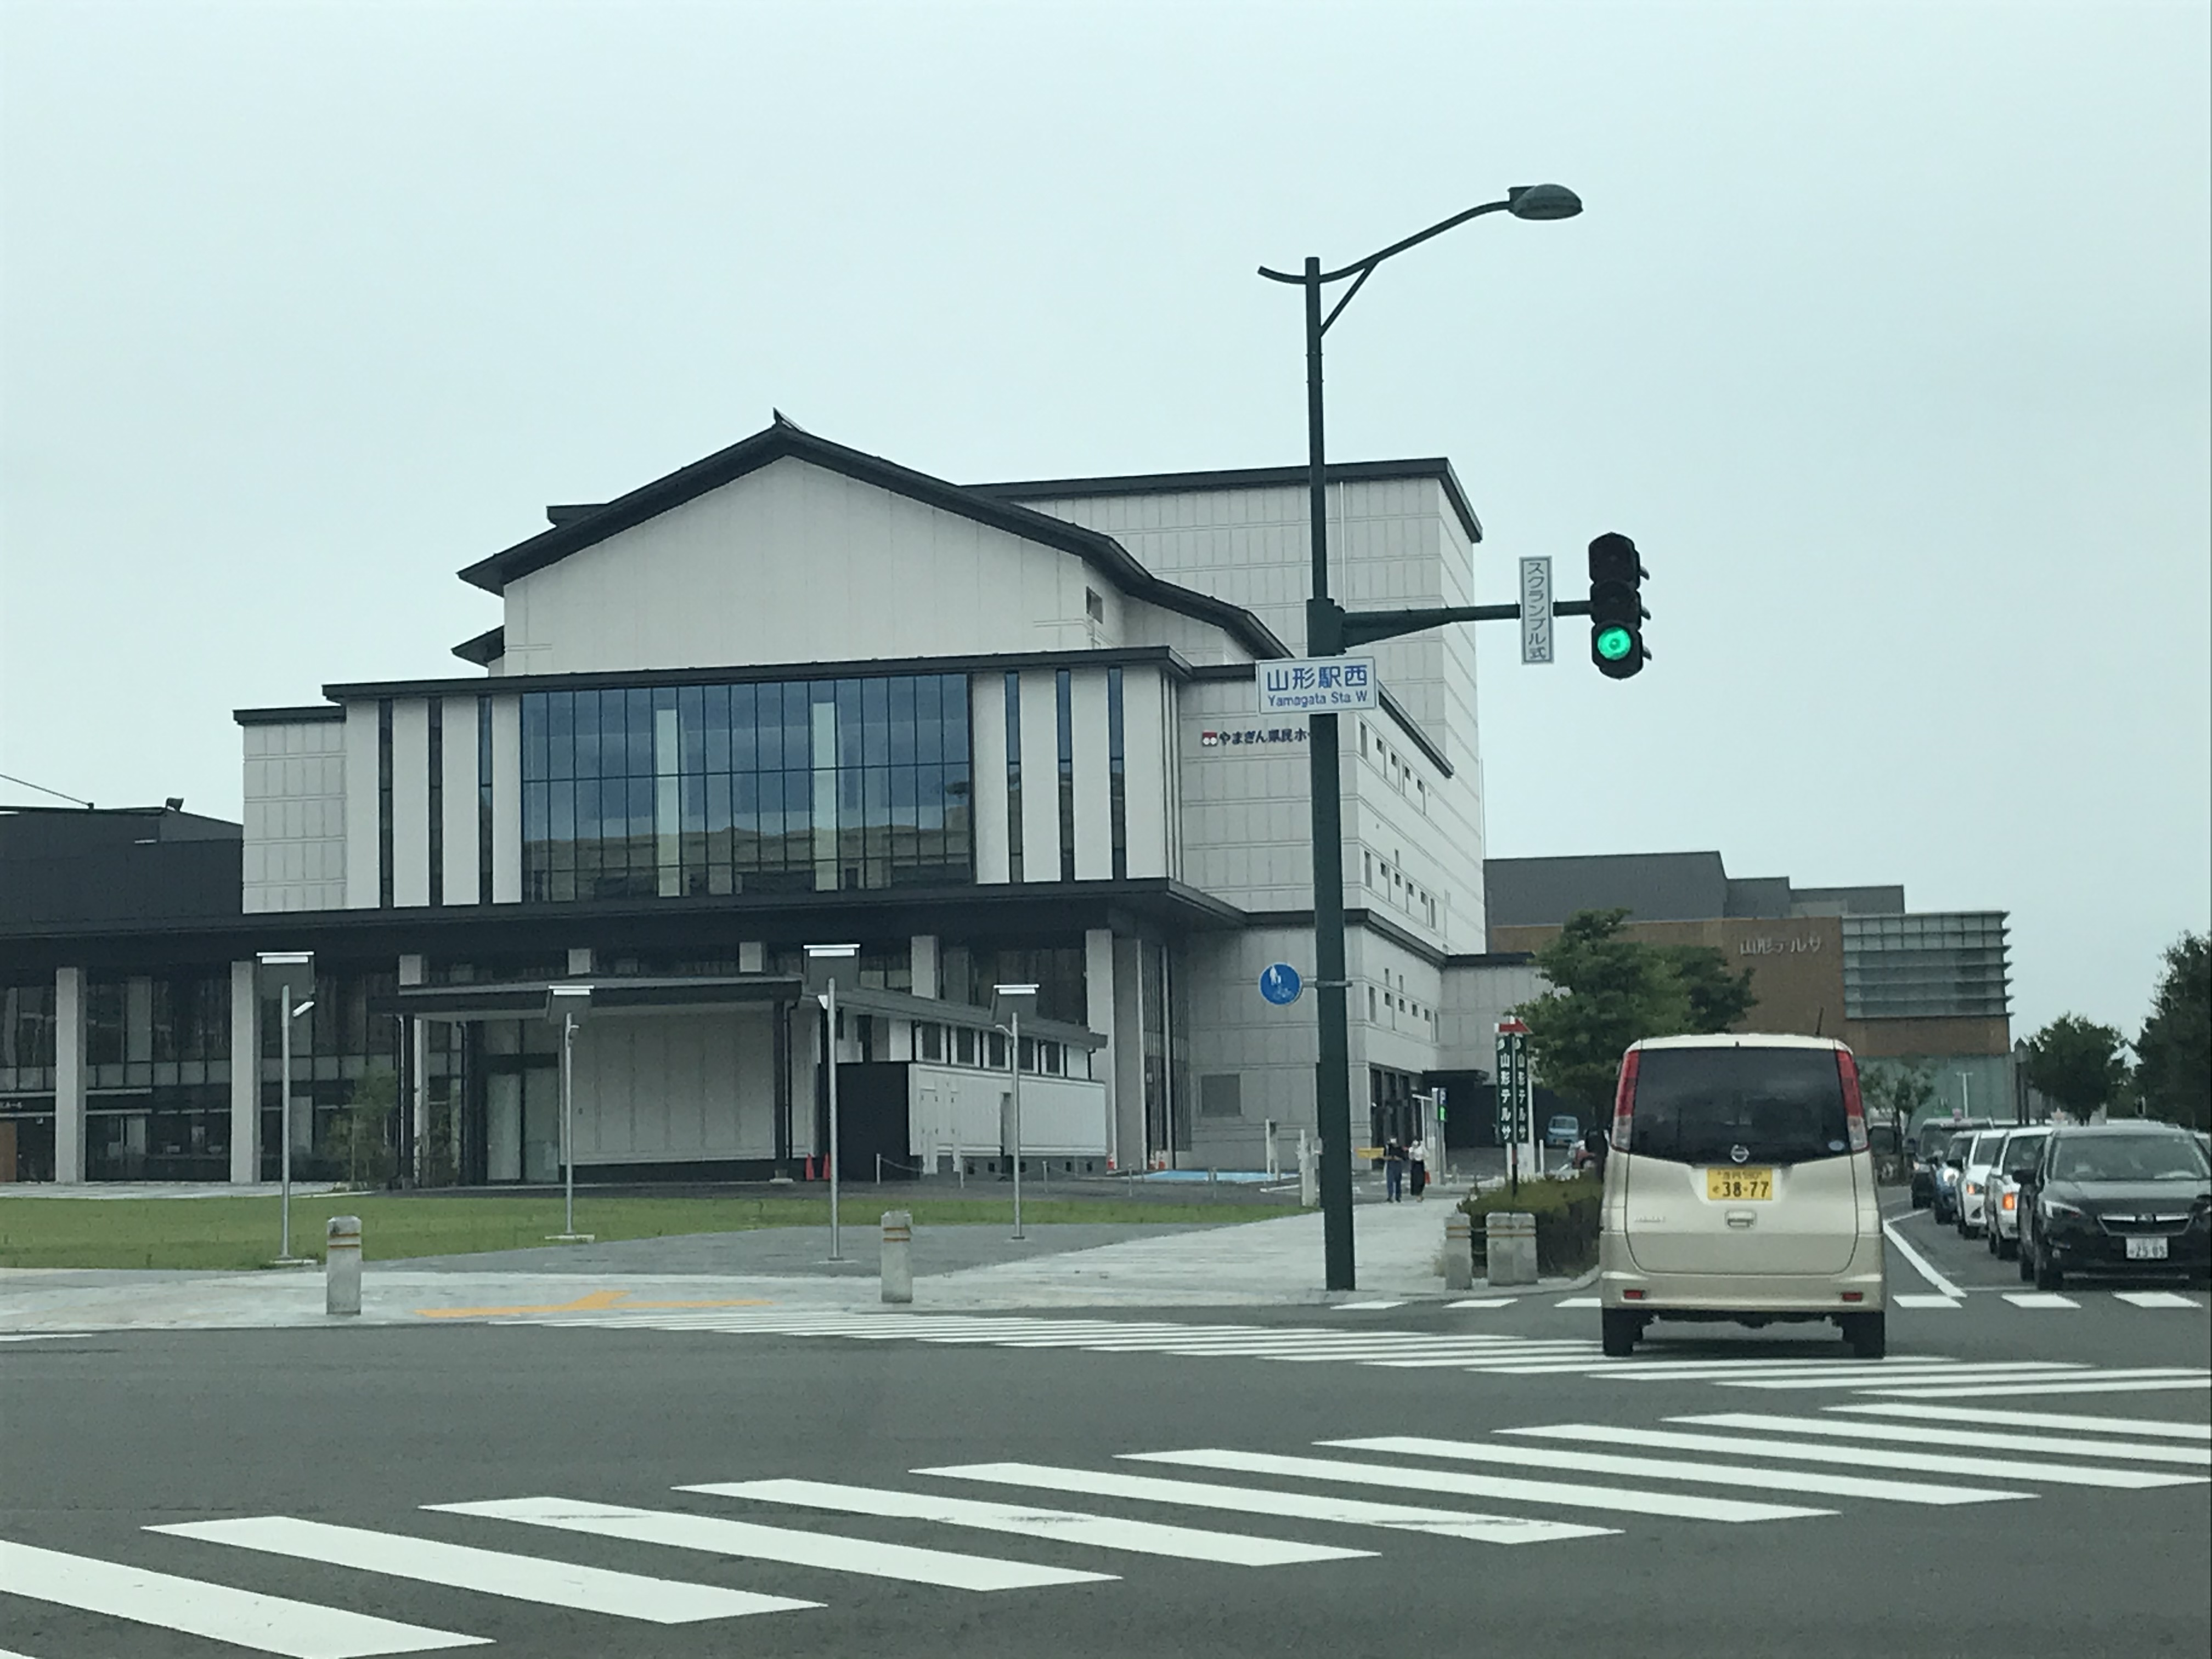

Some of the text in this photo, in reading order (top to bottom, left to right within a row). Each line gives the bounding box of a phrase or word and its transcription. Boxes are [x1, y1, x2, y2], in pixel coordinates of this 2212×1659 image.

[1267, 664, 1368, 692] 山形駅西
[1267, 690, 1368, 708] Yamagata Sta W
[1219, 727, 1310, 746] やまぎん県民ホ
[1500, 1053, 1511, 1140] 山形テルサ
